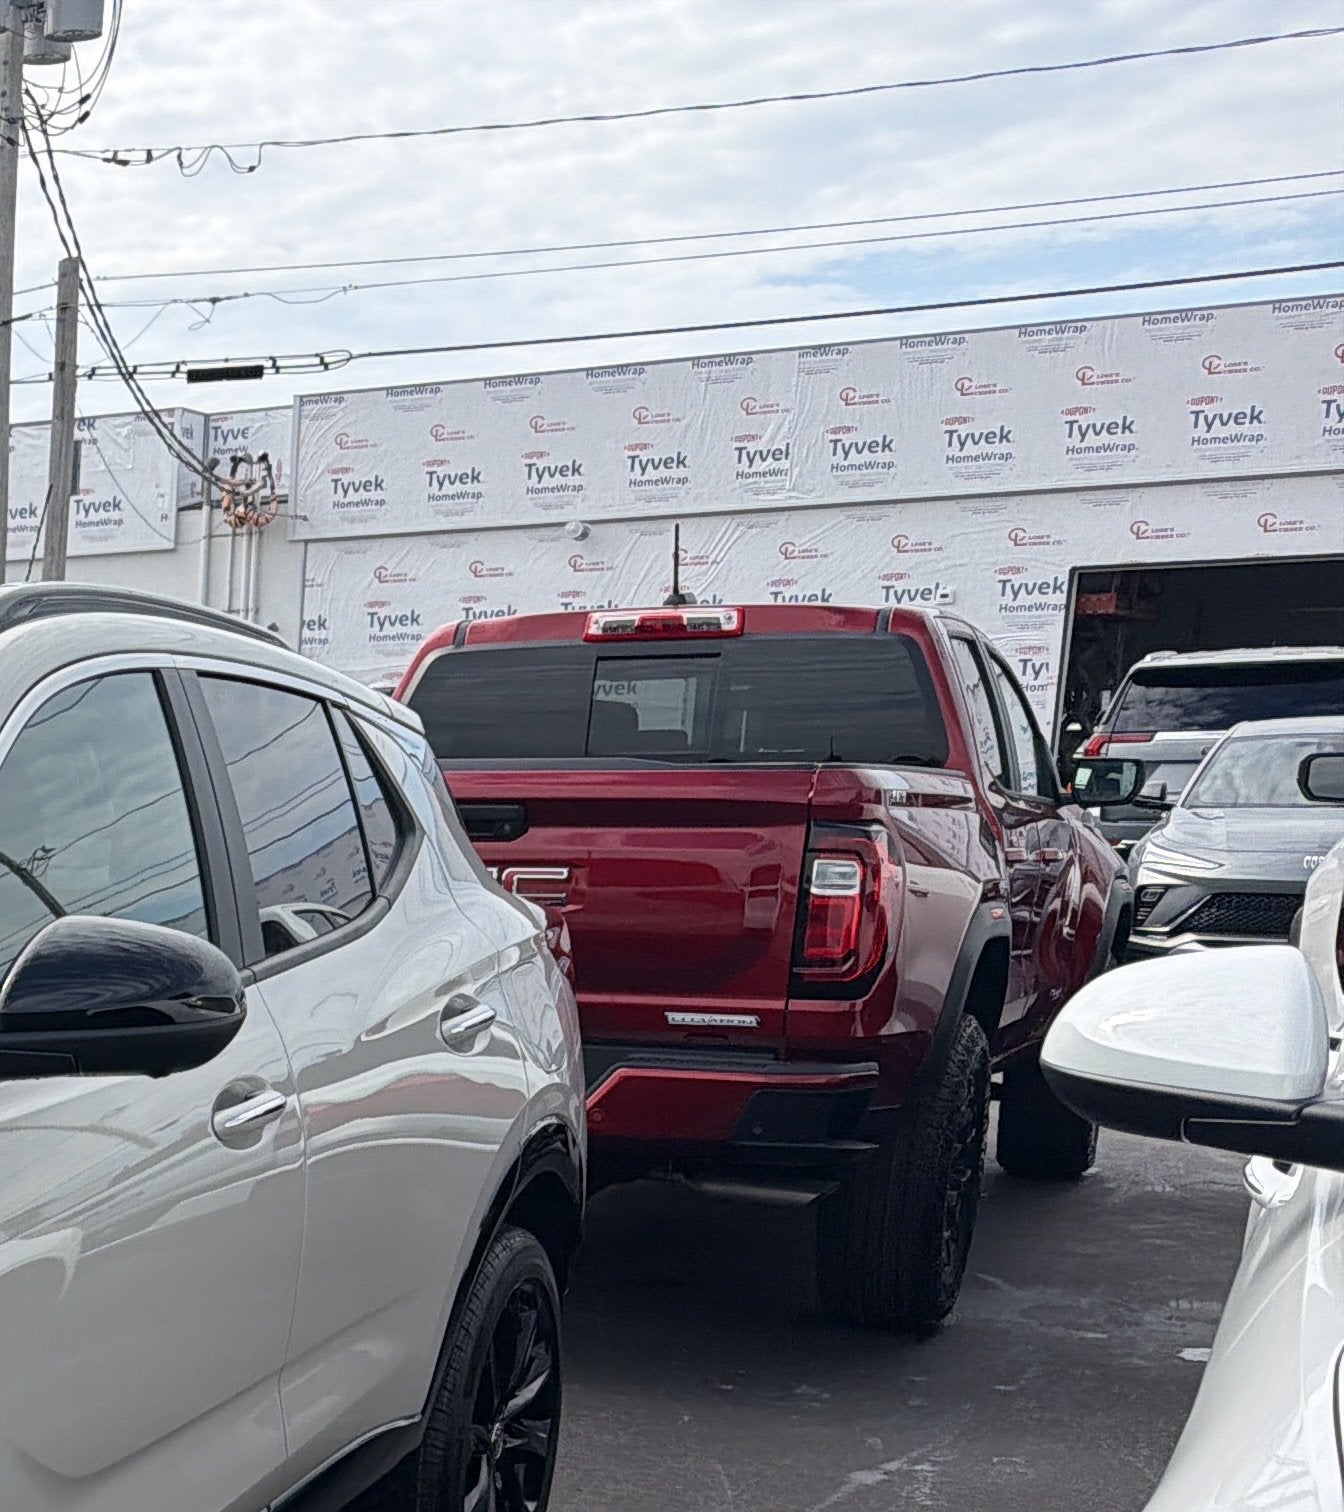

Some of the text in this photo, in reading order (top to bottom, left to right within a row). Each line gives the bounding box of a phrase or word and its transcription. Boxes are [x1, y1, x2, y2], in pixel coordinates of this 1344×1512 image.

[1142, 311, 1215, 327] HomeWrap
[1018, 323, 1088, 339] HomeWrap
[899, 335, 967, 350] HomeWrap
[691, 355, 754, 370] HomeWrap
[585, 366, 645, 380] HomeWrap
[483, 375, 542, 389] HomeWrap
[1189, 405, 1264, 433] Tyvek
[212, 426, 250, 444] Tyve
[1064, 416, 1136, 443] Tyvek
[944, 425, 1013, 452] Tyvek
[1191, 432, 1266, 447] HomeWrap
[829, 434, 895, 461] Tyvek
[1065, 441, 1138, 456] HomeWrap
[627, 451, 688, 477] Tyvek
[945, 450, 1014, 464] HomeWrap
[524, 459, 583, 484] Tyvek
[830, 459, 896, 473] HomeWrap
[330, 475, 385, 499] Tyvek
[425, 467, 482, 491] Tyvek
[628, 475, 690, 489] HomeWrap
[427, 490, 484, 503] HomeWrap
[526, 483, 585, 496] HomeWrap
[9, 502, 38, 520] vek
[74, 496, 122, 519] Tyvek
[332, 497, 386, 510] HomeWrap
[75, 517, 124, 529] HomeWrap
[997, 576, 1066, 602] Tyvek
[367, 609, 422, 632] Tyvek
[368, 631, 424, 643] HomeWrap
